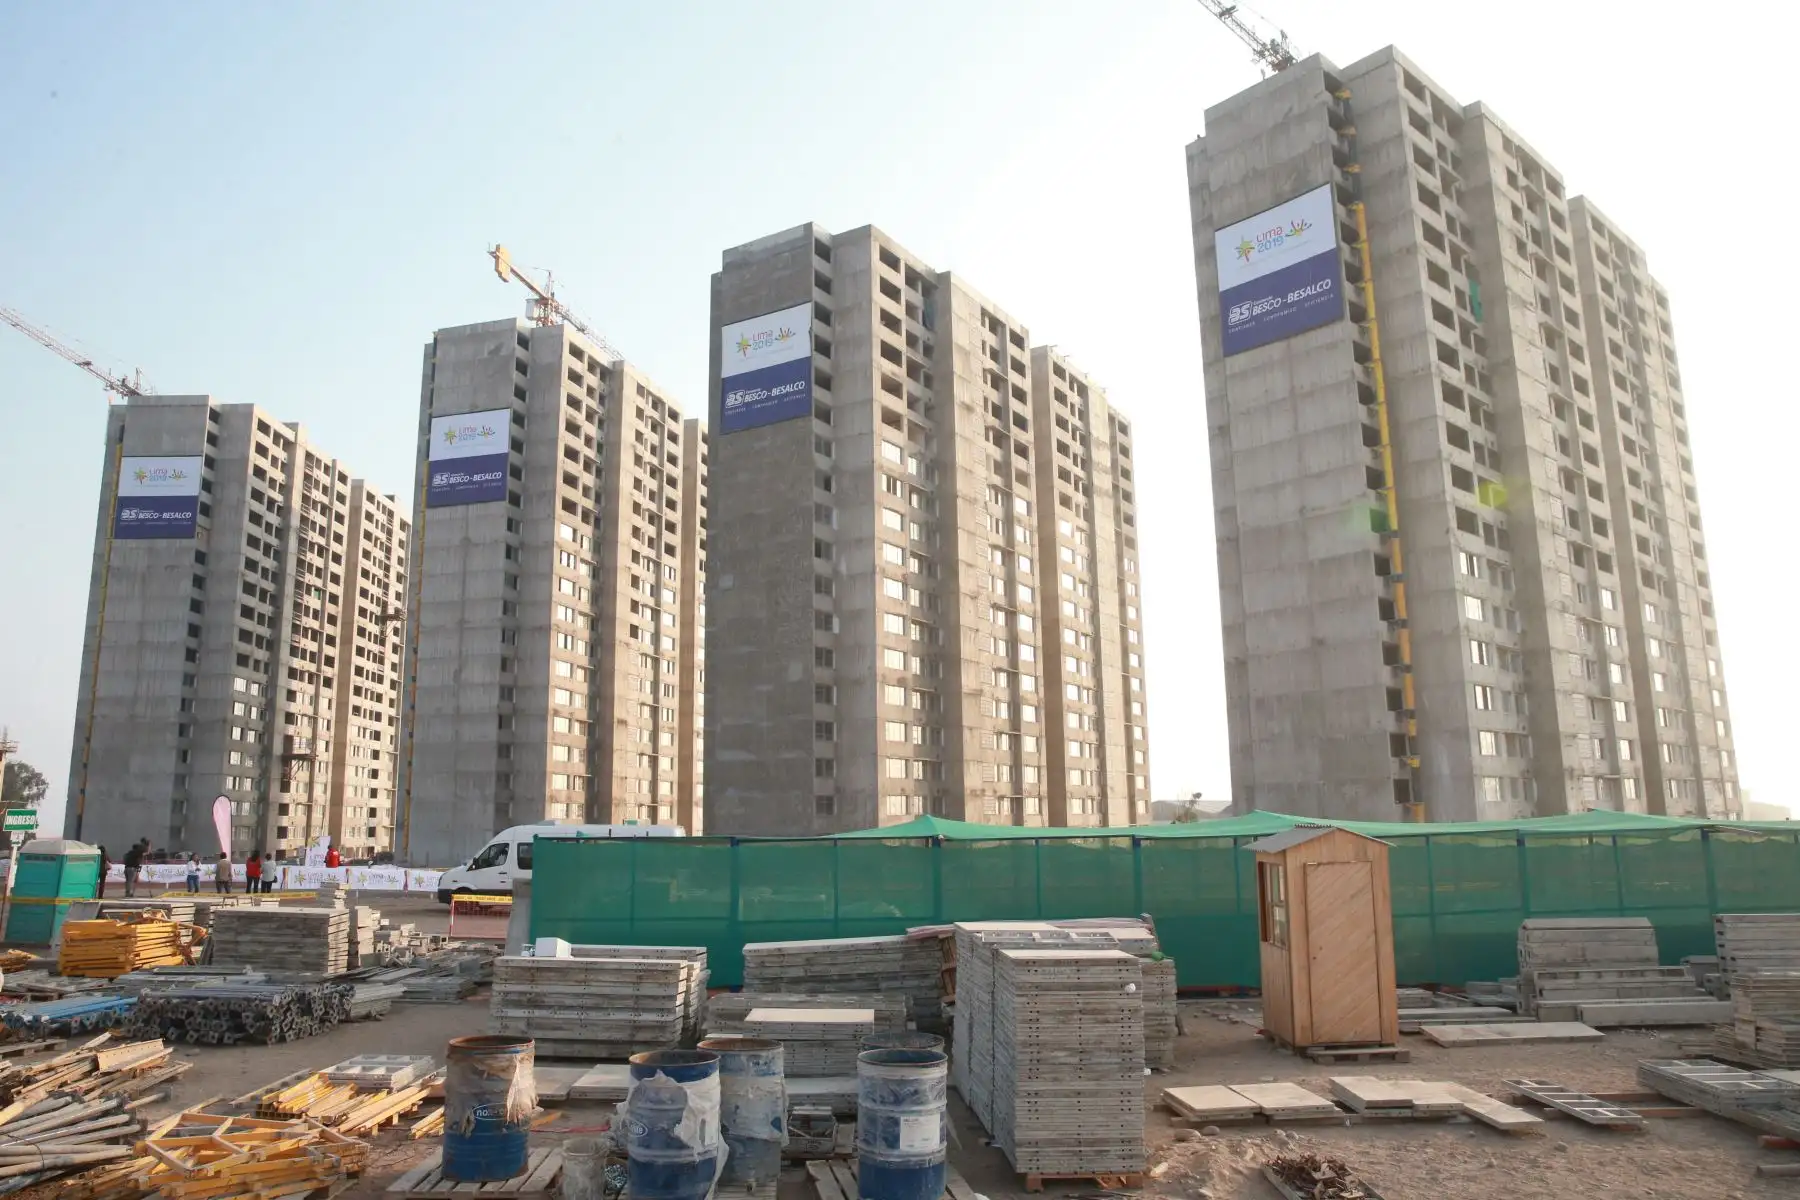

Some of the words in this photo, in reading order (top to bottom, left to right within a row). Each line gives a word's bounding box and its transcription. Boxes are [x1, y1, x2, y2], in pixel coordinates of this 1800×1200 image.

[1257, 236, 1284, 253] 2019
[752, 339, 774, 351] 2019
[6, 815, 36, 825] INGRESO
